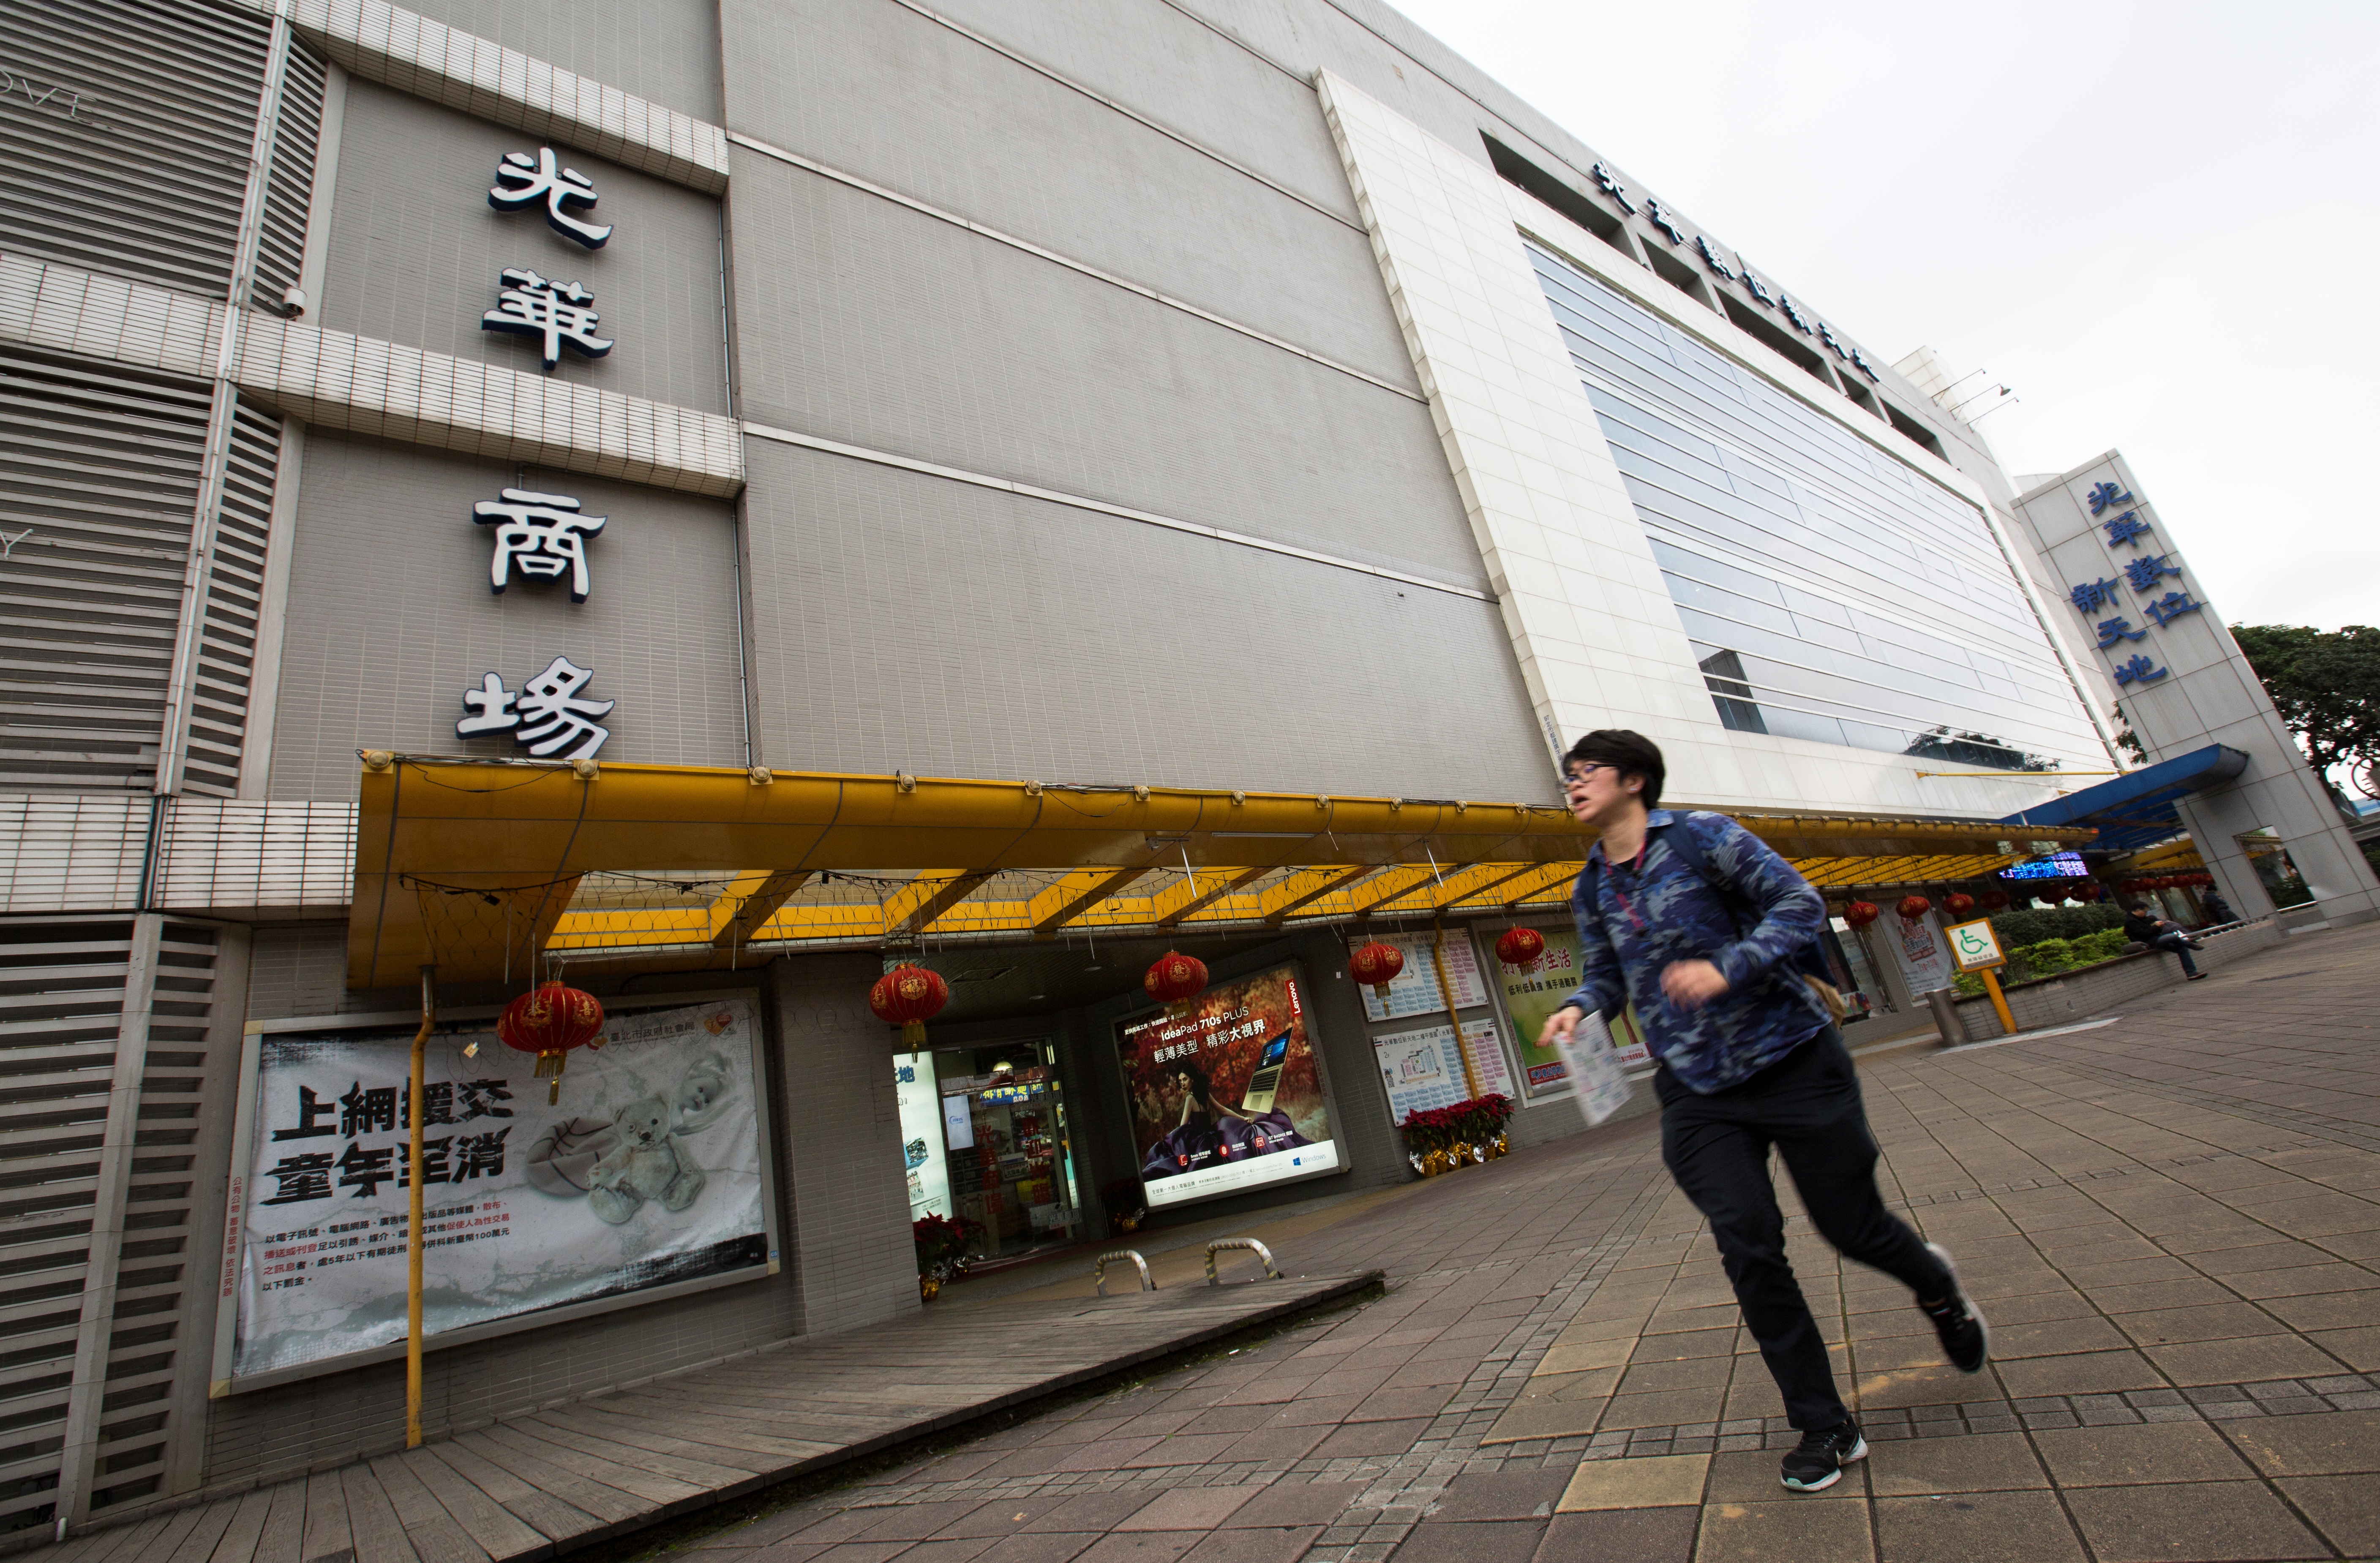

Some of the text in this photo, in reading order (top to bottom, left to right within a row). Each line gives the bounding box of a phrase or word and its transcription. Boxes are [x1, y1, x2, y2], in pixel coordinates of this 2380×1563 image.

[1593, 160, 1880, 382] 光華數位新天地
[455, 147, 615, 759] 光華商場
[2087, 482, 2200, 628] 光華數位
[2070, 577, 2167, 686] 新天地
[1501, 947, 1571, 976] 打新生活
[1289, 980, 1301, 1015] Lenovo
[611, 1021, 695, 1042] 臺北市政府社會局
[1153, 1018, 1266, 1064] 輕薄美型 精彩大視界
[1161, 1006, 1249, 1042] IdeaPad 710s PLUS
[1301, 1153, 1327, 1164] Windows
[231, 1176, 243, 1214] 公有公物
[1152, 1181, 1196, 1195] 全球第一大個人電腦品牌
[264, 1201, 507, 1244] 以電子訊號、電腦網路、廣告物出版品等媒體，散布、
[264, 1213, 510, 1260] 播送或刊登足以引誘、媒介、暗或其他促使人為性交易
[263, 1227, 510, 1276] 之訊息者，處5年以下有期徒刑得併科新臺幣100萬元
